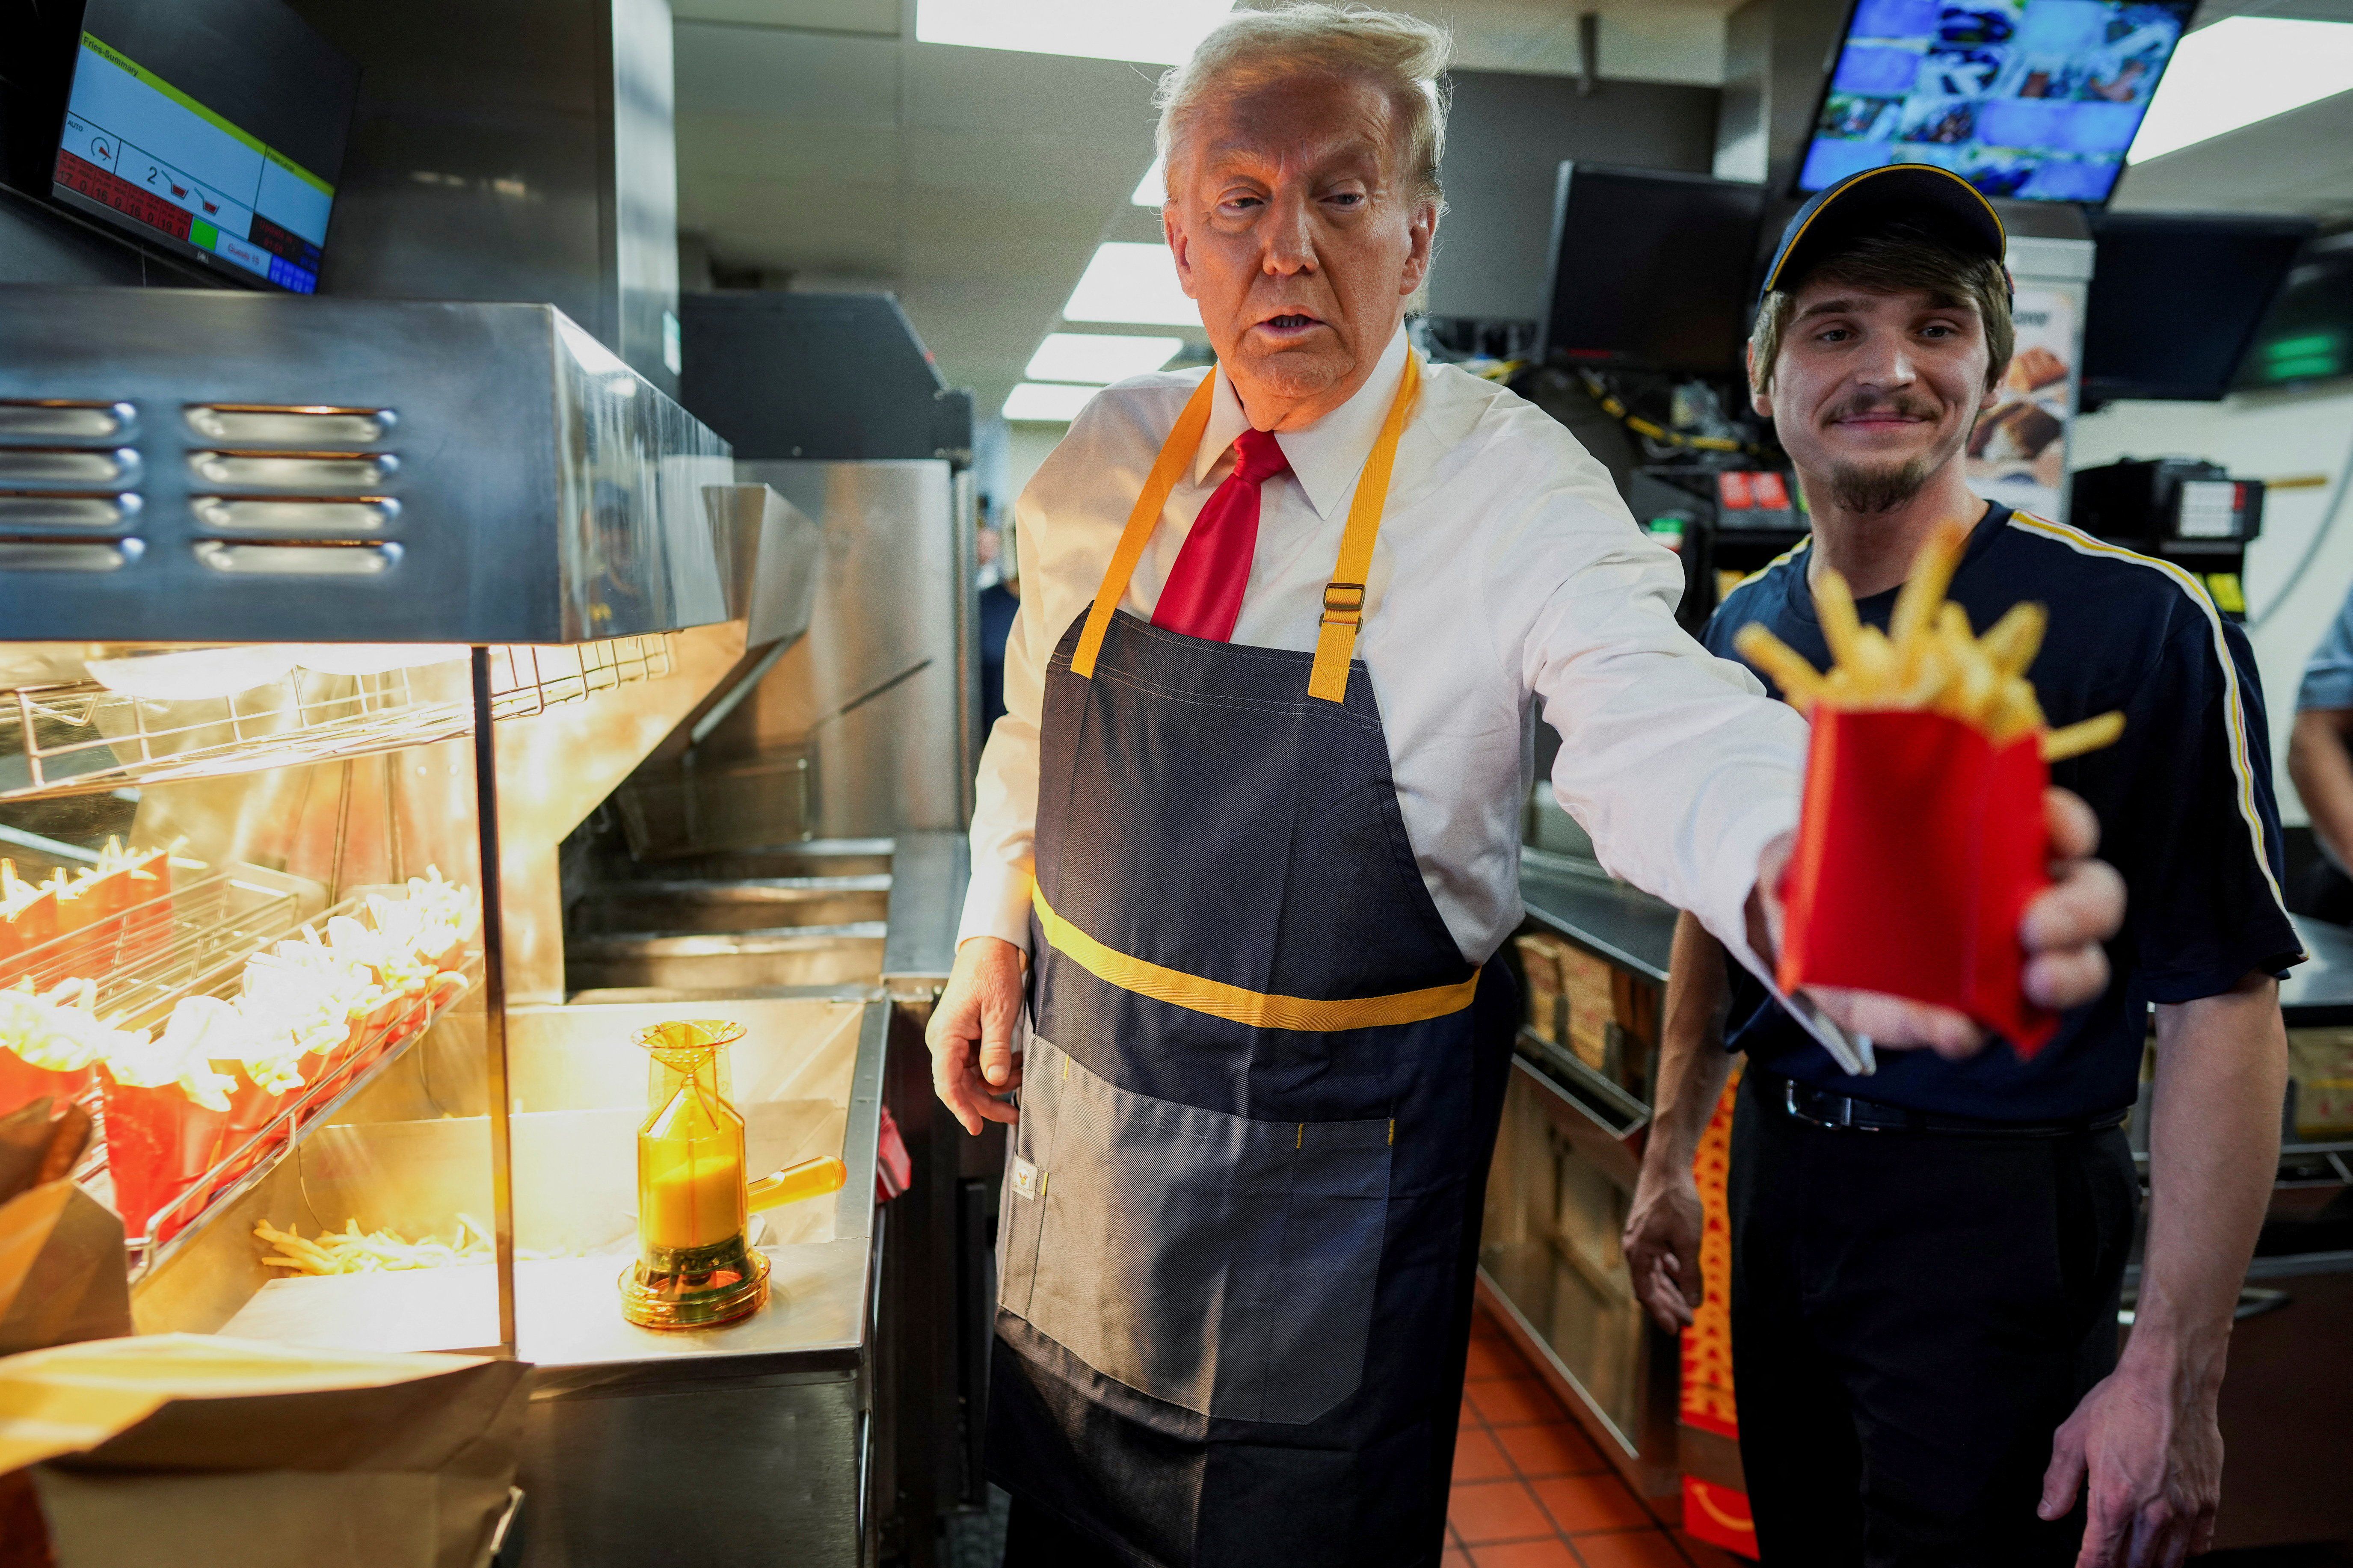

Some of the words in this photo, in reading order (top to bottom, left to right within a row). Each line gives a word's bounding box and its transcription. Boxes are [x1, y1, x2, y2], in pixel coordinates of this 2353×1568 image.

[83, 36, 139, 77] Fries-Summary
[67, 120, 83, 132] AUTO
[60, 171, 73, 184] 17
[80, 180, 87, 192] 0
[147, 166, 157, 185] 2
[96, 187, 107, 201] 16
[147, 212, 154, 223] 0
[177, 227, 184, 238] 0
